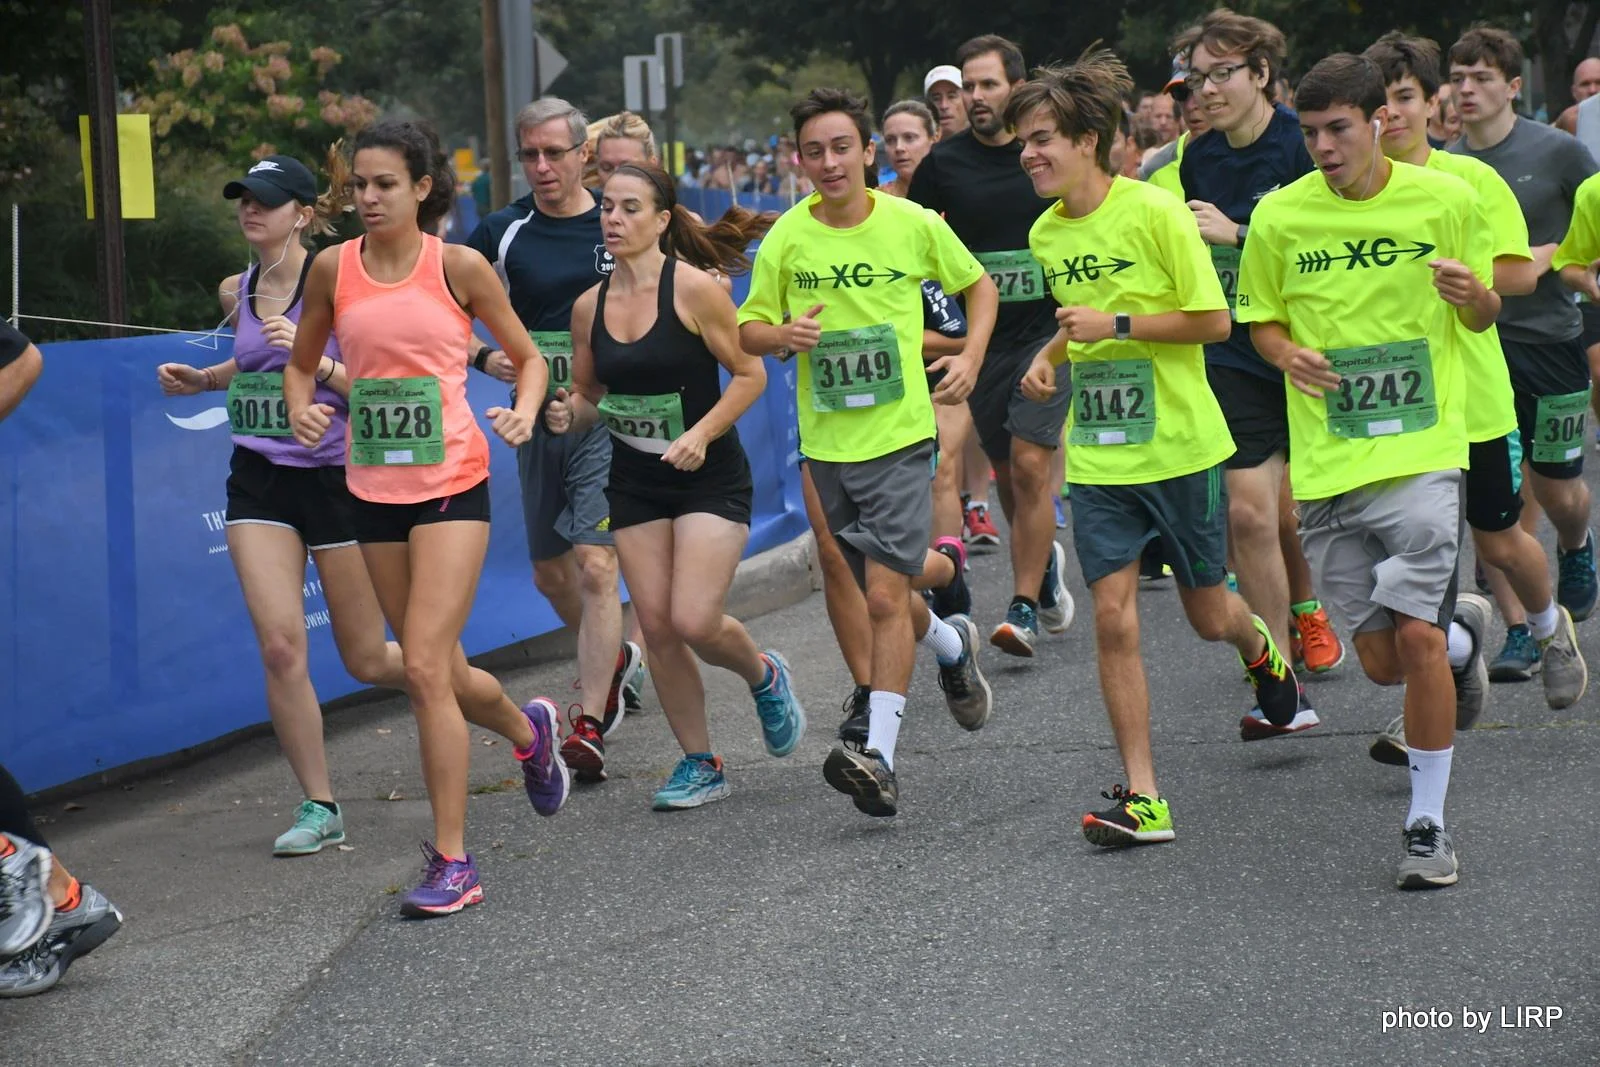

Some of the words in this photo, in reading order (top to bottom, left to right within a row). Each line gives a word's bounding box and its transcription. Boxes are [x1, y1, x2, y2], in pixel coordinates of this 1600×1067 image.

[1063, 254, 1100, 285] XC
[1343, 237, 1398, 270] XC
[830, 263, 874, 289] XC
[1239, 294, 1250, 306] 21
[818, 350, 892, 388] 3149
[1333, 356, 1375, 369] Capital
[1391, 354, 1415, 363] Bank
[359, 388, 390, 397] Capital
[1080, 386, 1147, 422] 3142
[1336, 370, 1425, 412] 3242
[232, 398, 291, 430] 3019
[359, 405, 432, 440] 3128
